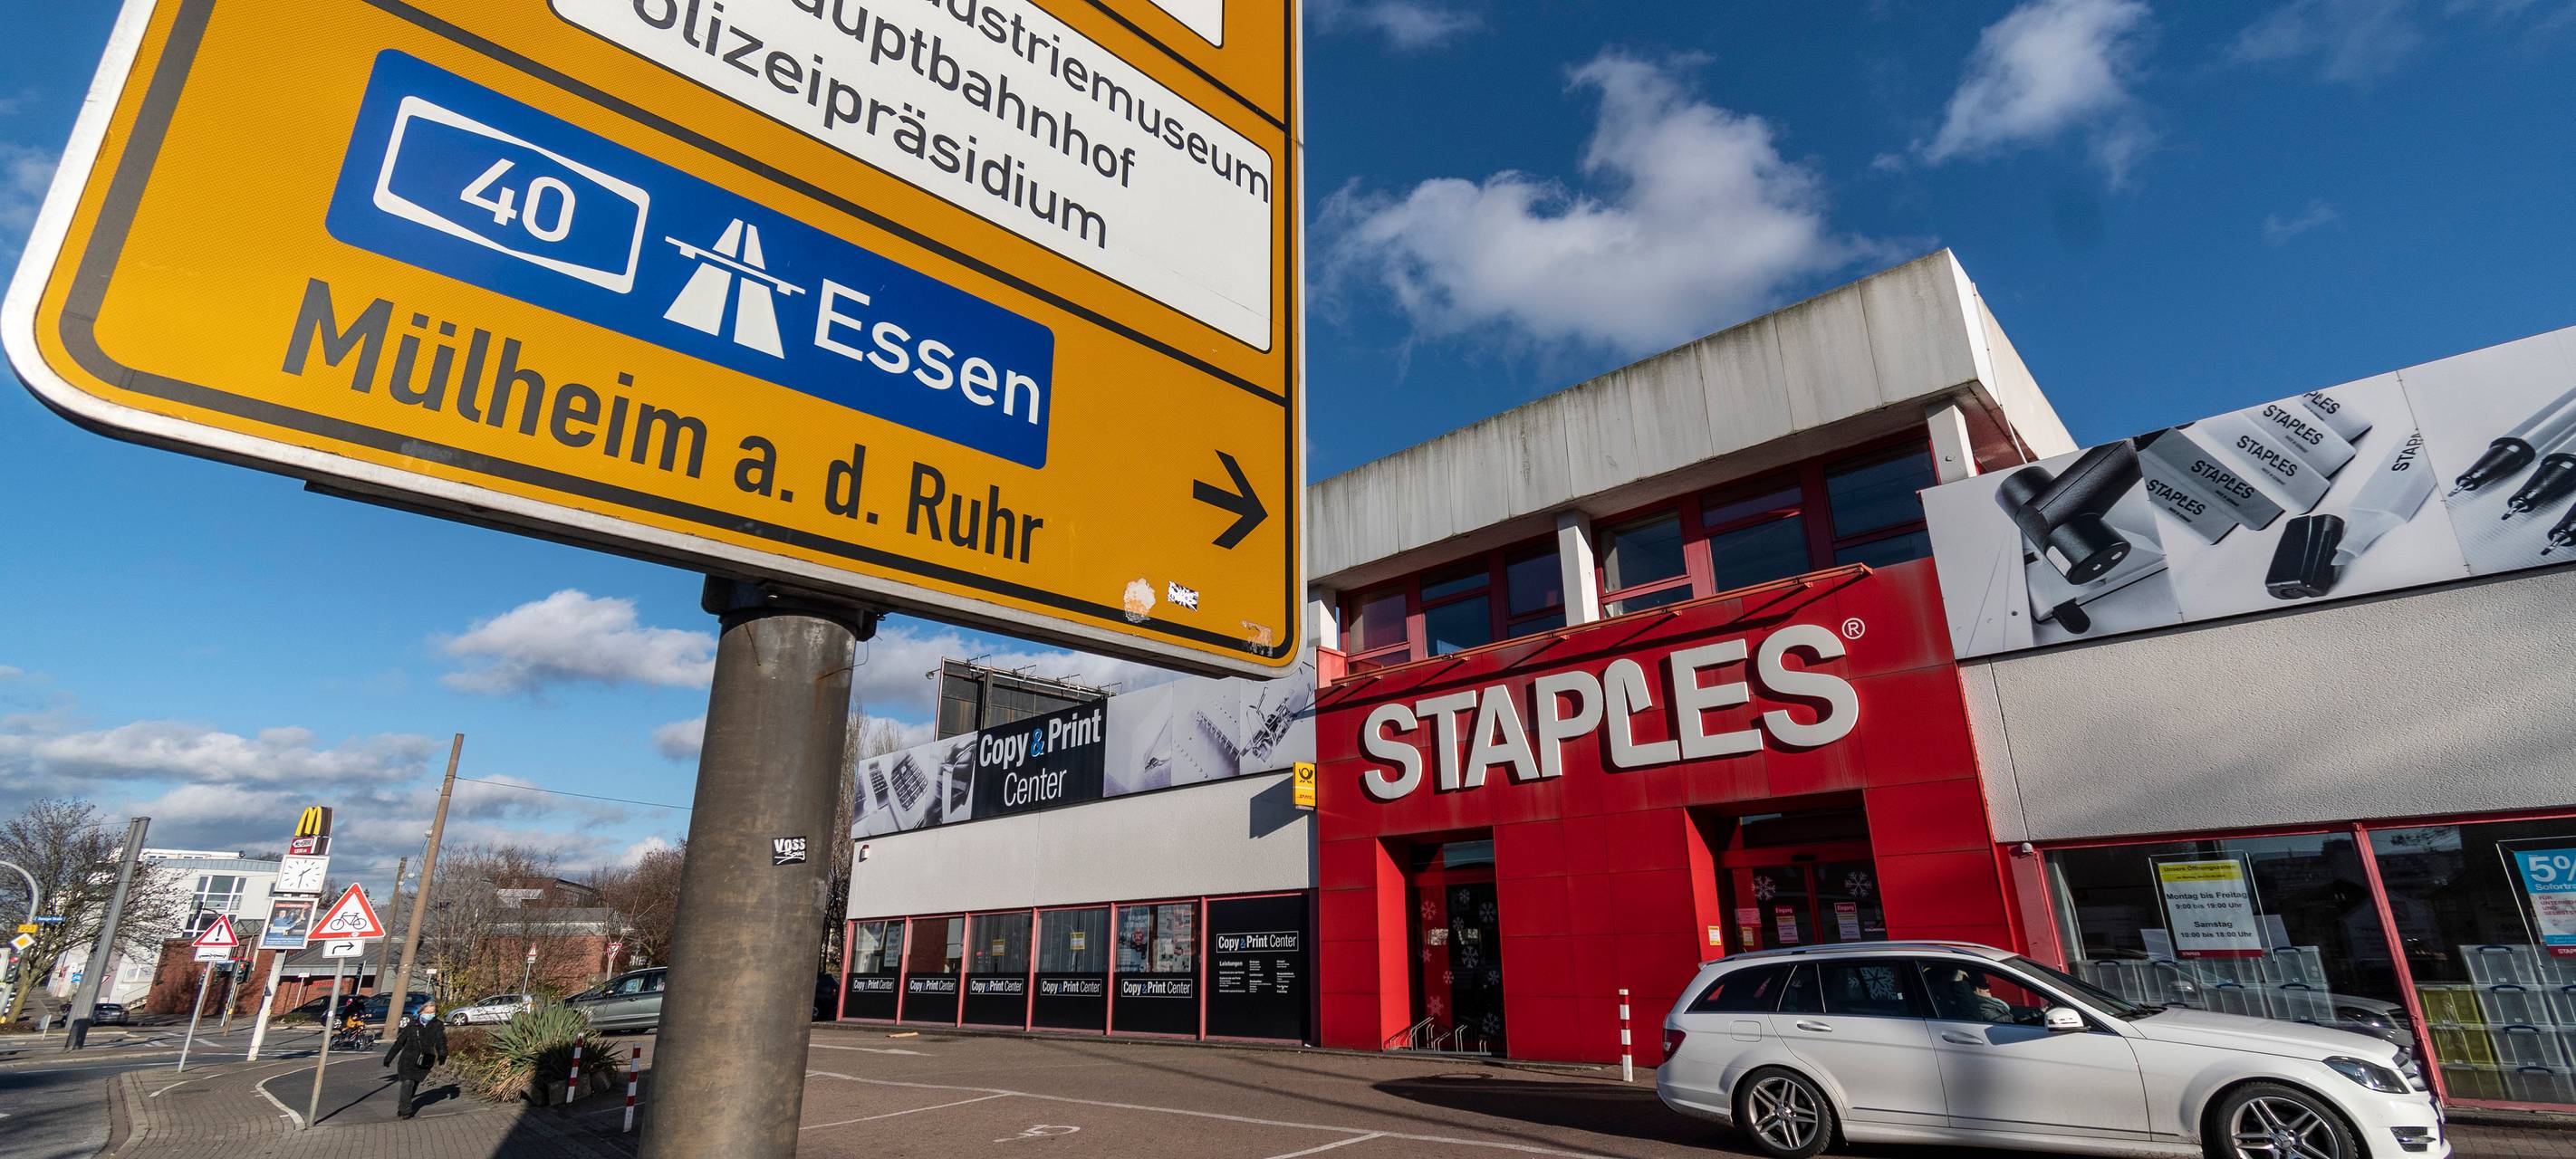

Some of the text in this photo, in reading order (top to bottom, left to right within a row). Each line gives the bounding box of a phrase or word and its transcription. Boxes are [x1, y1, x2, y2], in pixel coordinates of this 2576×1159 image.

[925, 0, 1269, 204] ustriemuseum
[459, 158, 576, 243] 40
[813, 278, 1041, 426] Essen
[281, 277, 1044, 564] Mülheim a. d. Ruhr
[2263, 404, 2324, 445] STAPLES
[2236, 435, 2298, 477] STAPLES
[2147, 479, 2206, 515] STAPLES
[2191, 460, 2255, 499] STAPLES
[979, 708, 1101, 770] Copy & Print
[1004, 768, 1068, 807] Center
[1218, 936, 1239, 952] Copy
[1246, 934, 1268, 948] Print
[1269, 934, 1297, 948] Center
[853, 980, 865, 991] Copy
[868, 980, 879, 990] Print
[879, 980, 893, 990] Center
[909, 980, 922, 991] Copy
[926, 980, 938, 991] Print
[938, 981, 955, 991] Center
[971, 981, 985, 993] Copy
[989, 981, 1004, 991] Print
[1004, 982, 1023, 992] Center
[1042, 981, 1059, 994] Copy
[1062, 981, 1080, 992] Print
[1080, 982, 1101, 993] Center
[1123, 981, 1142, 996] Copy
[1147, 981, 1167, 994] Print
[1167, 981, 1191, 994] Center
